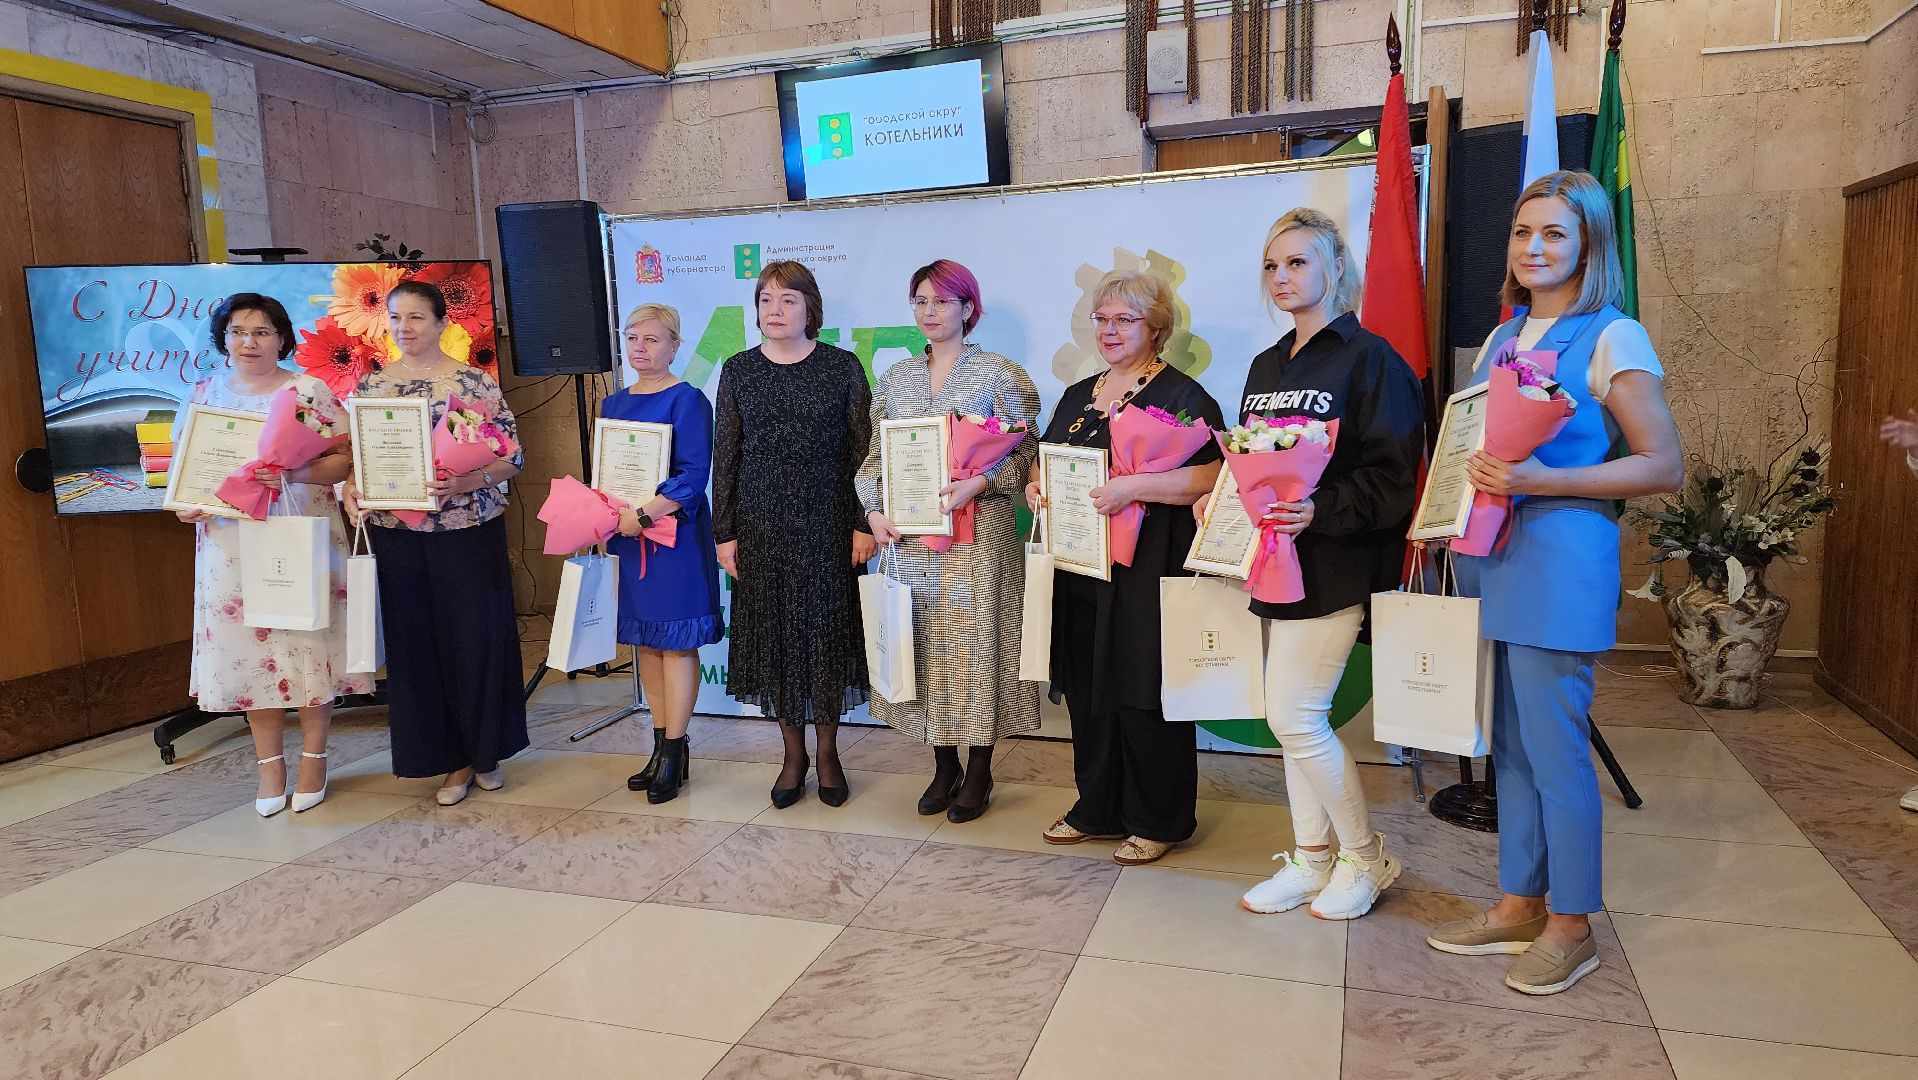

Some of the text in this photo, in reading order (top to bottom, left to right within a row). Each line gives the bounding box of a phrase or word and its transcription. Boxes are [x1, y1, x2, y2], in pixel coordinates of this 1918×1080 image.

[928, 105, 962, 119] округ
[864, 122, 964, 147] КОТЕЛЬНИКИ
[766, 243, 835, 255] Администрация
[666, 253, 707, 263] Команда
[817, 254, 847, 264] округа
[666, 264, 726, 275] губернатора
[72, 279, 225, 321] С Дне
[56, 349, 234, 402] учител
